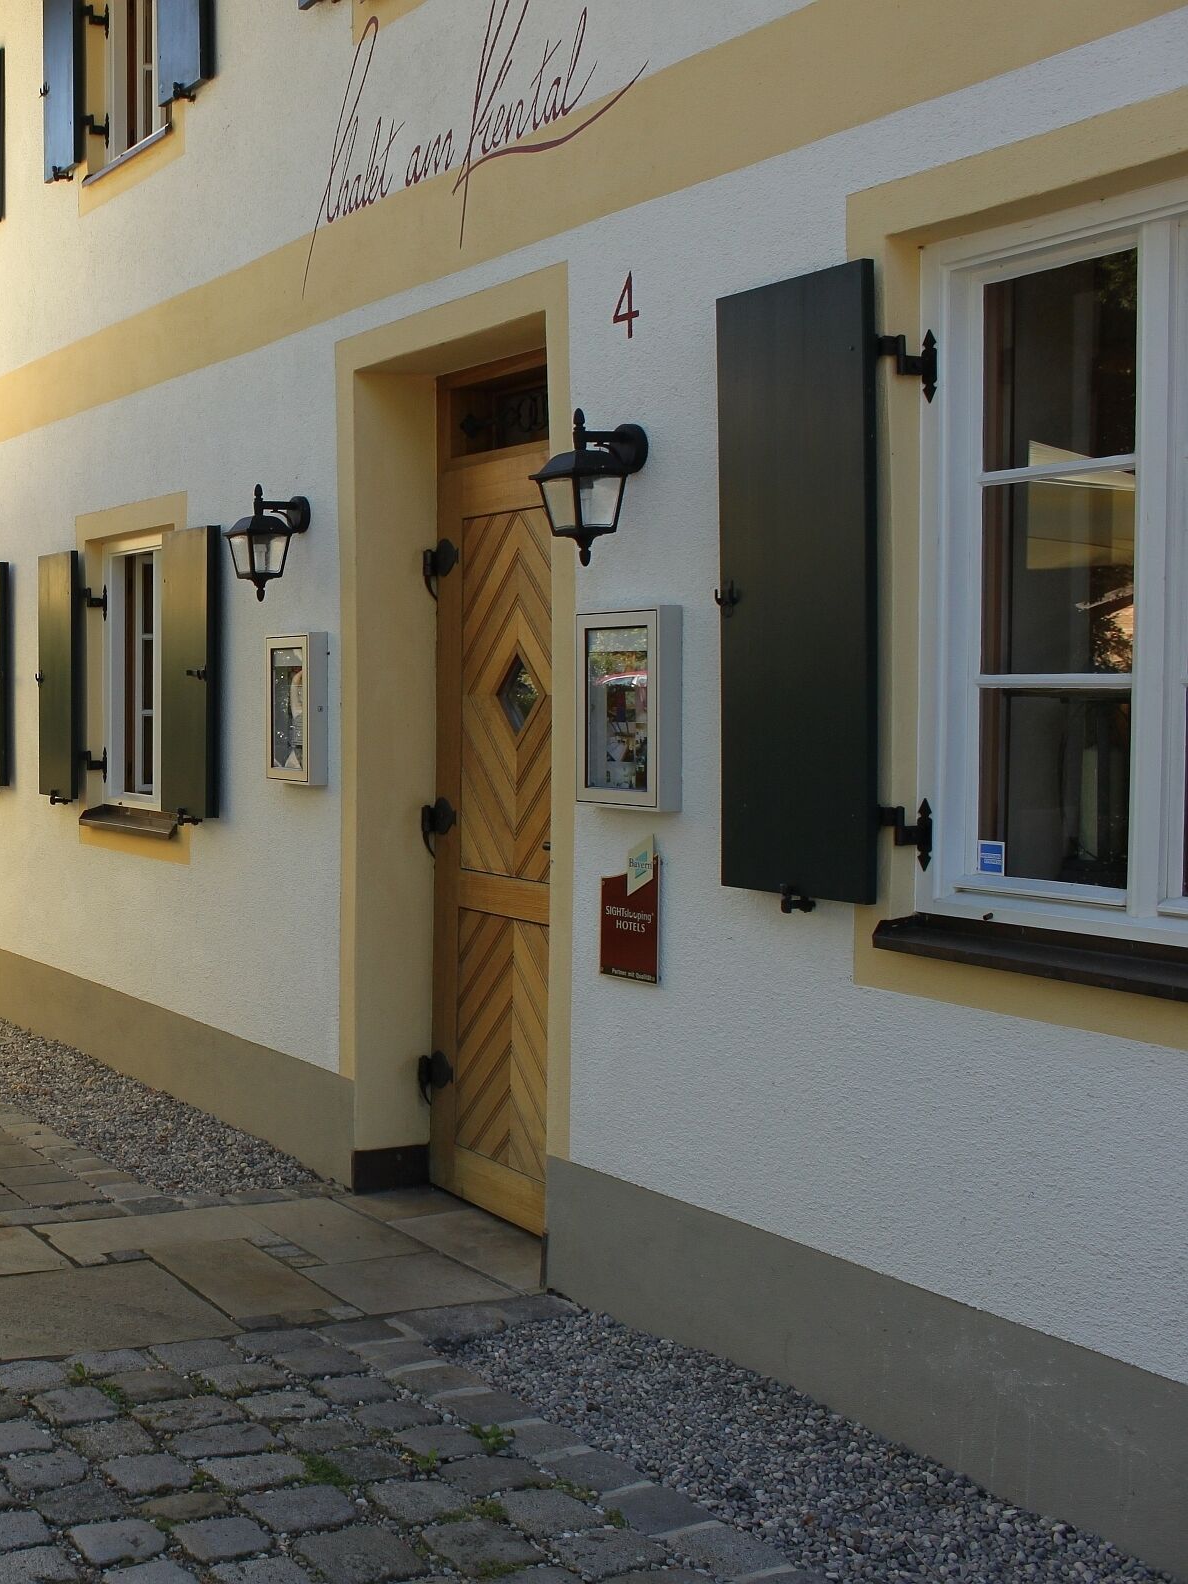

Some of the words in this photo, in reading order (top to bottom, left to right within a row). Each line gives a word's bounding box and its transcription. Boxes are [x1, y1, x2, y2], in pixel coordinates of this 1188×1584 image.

[405, 129, 455, 187] am
[613, 270, 639, 339] 4
[629, 857, 653, 870] Bayern
[615, 919, 646, 933] HOTELS
